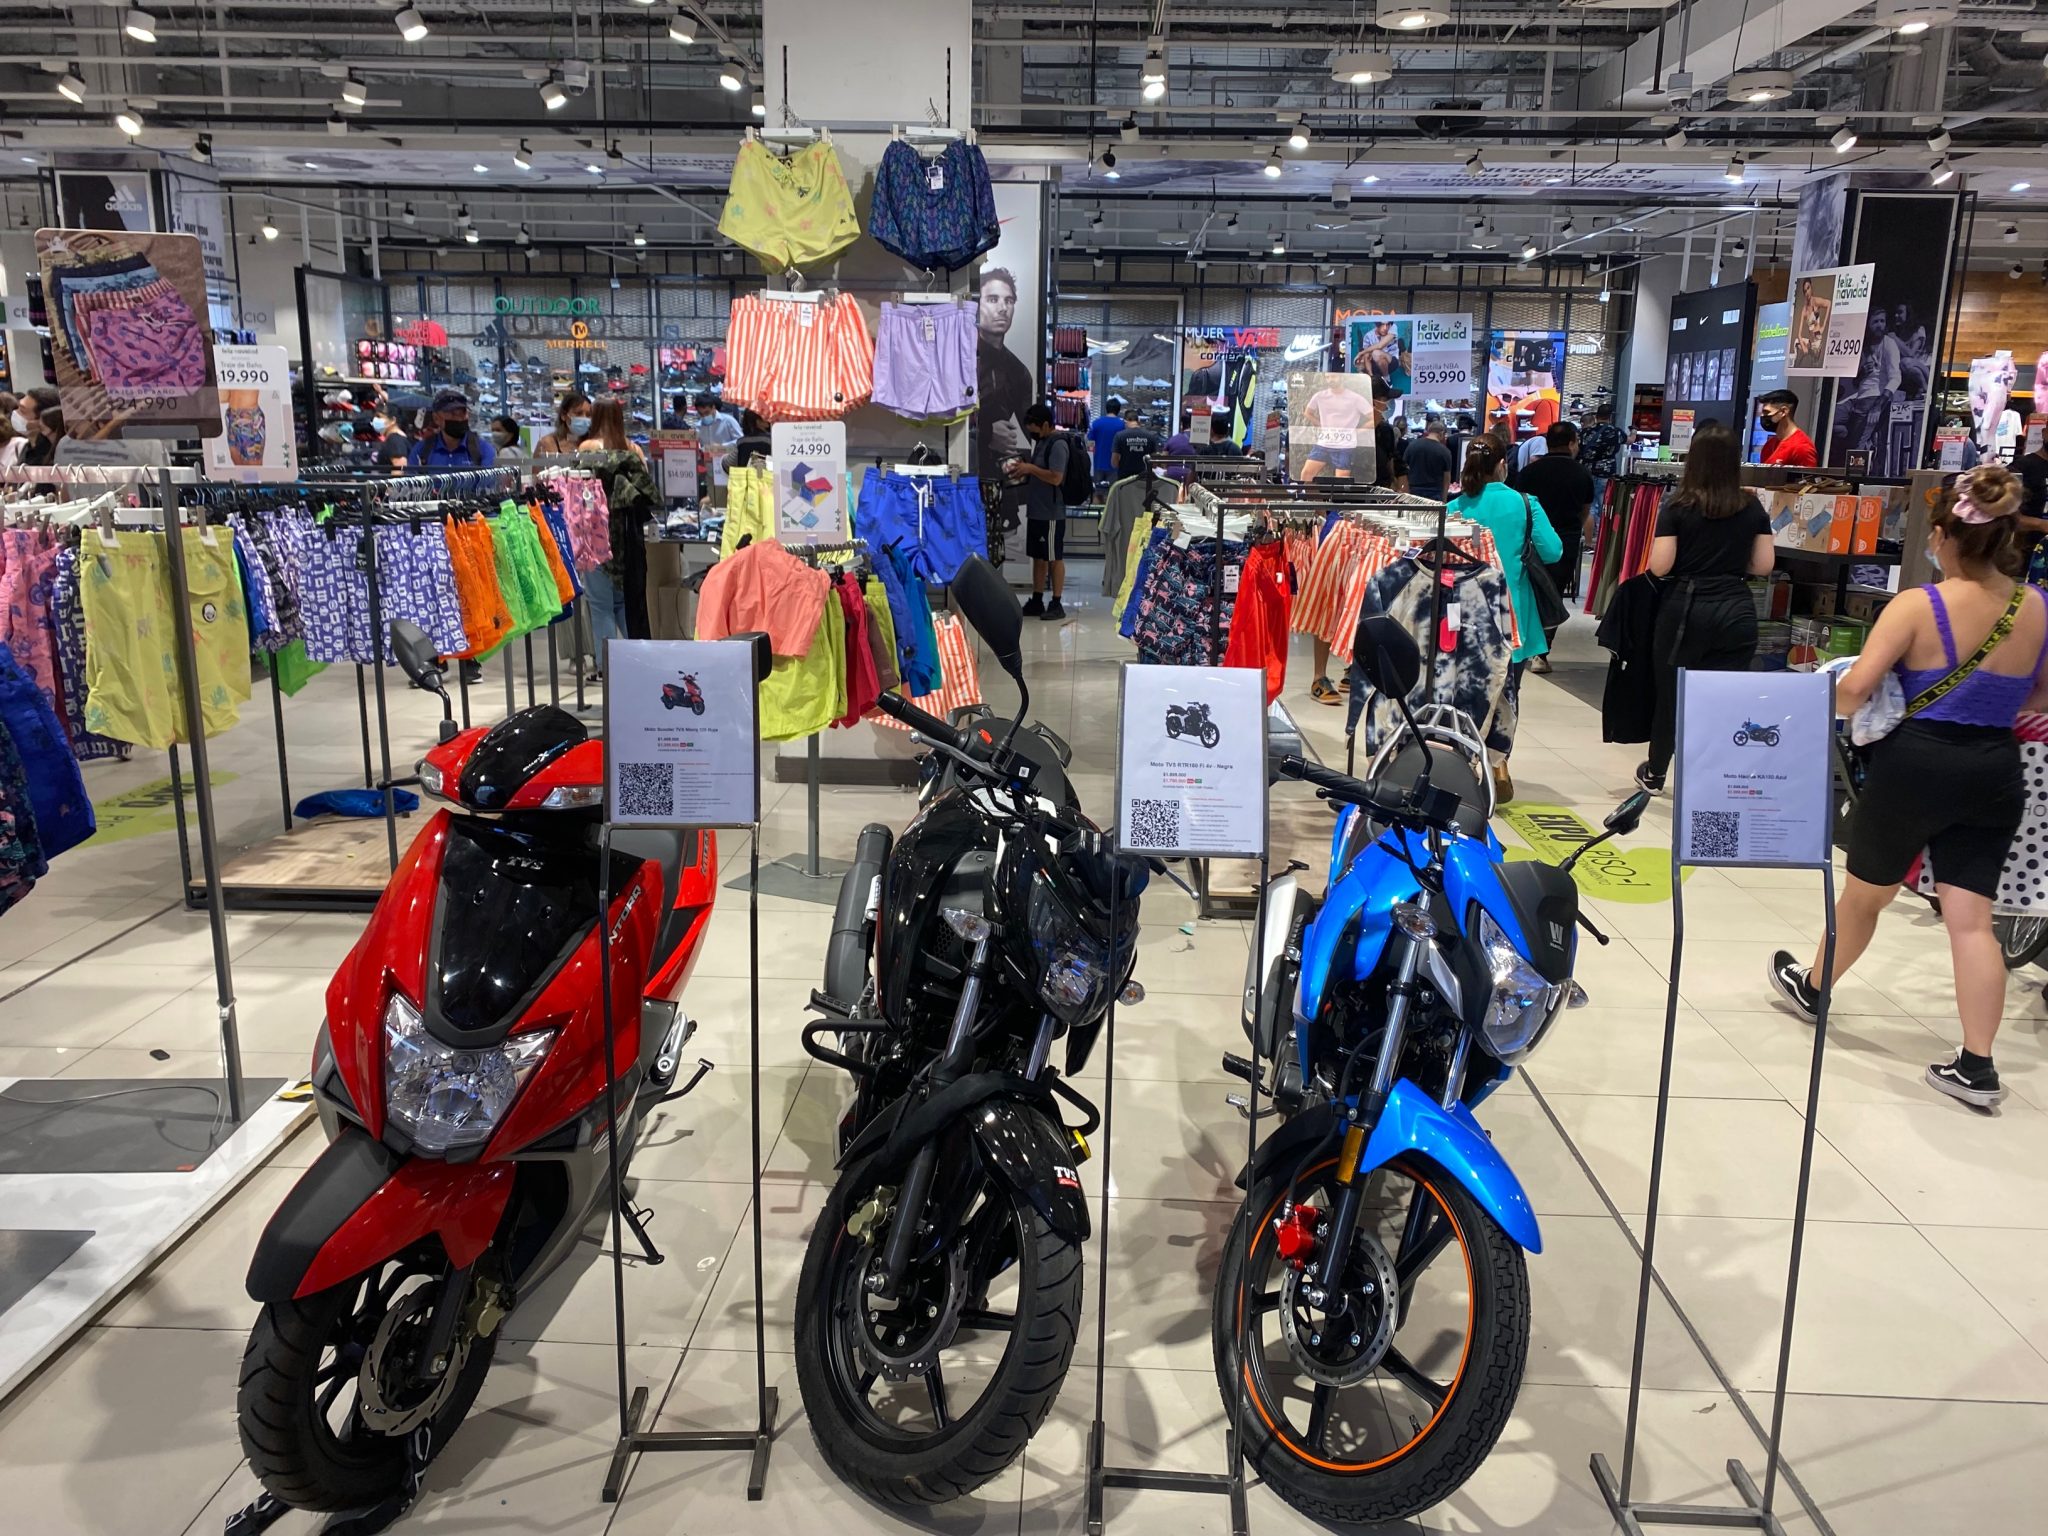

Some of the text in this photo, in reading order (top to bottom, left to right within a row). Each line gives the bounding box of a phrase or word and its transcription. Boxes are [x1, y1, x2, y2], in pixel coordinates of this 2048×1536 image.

[105, 202, 143, 211] adidas
[1837, 273, 1853, 288] feliz
[1836, 282, 1869, 299] navidad
[494, 296, 601, 315] OUTDOOR
[1185, 327, 1225, 338] MUJER
[1417, 320, 1440, 332] feliz
[1417, 327, 1467, 340] navidad
[545, 340, 608, 349] MERRELL
[1233, 328, 1280, 347] VANS
[1291, 334, 1322, 350] NIKE
[1569, 344, 1597, 354] PUMA
[1526, 813, 1599, 842] EXPO
[1053, 1165, 1078, 1182] TVS
